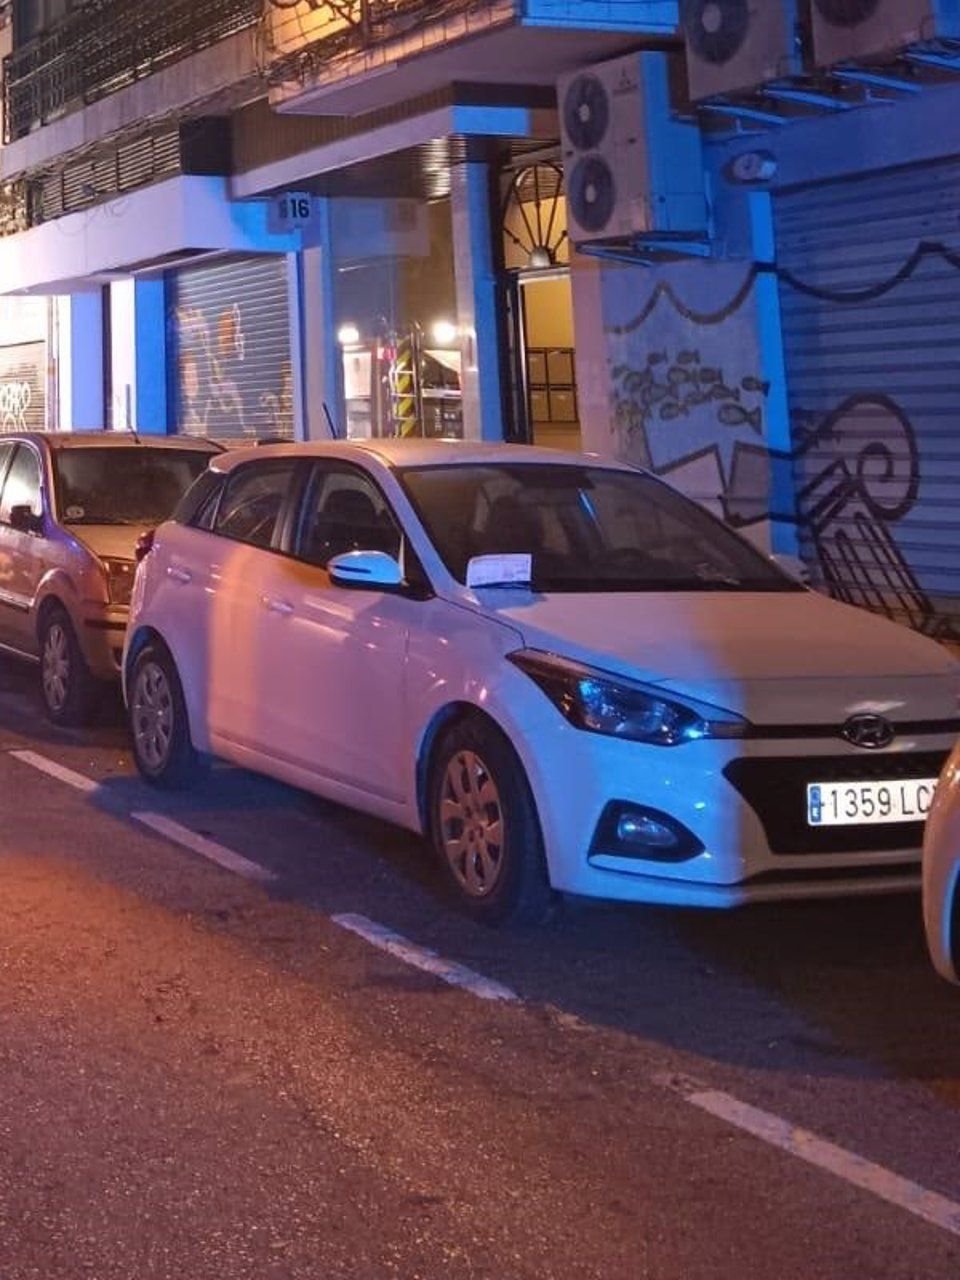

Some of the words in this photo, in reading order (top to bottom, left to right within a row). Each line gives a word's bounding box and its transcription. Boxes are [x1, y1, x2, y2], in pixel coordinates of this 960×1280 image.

[290, 199, 310, 218] 16
[831, 787, 892, 819] 1359
[900, 784, 938, 816] LC
